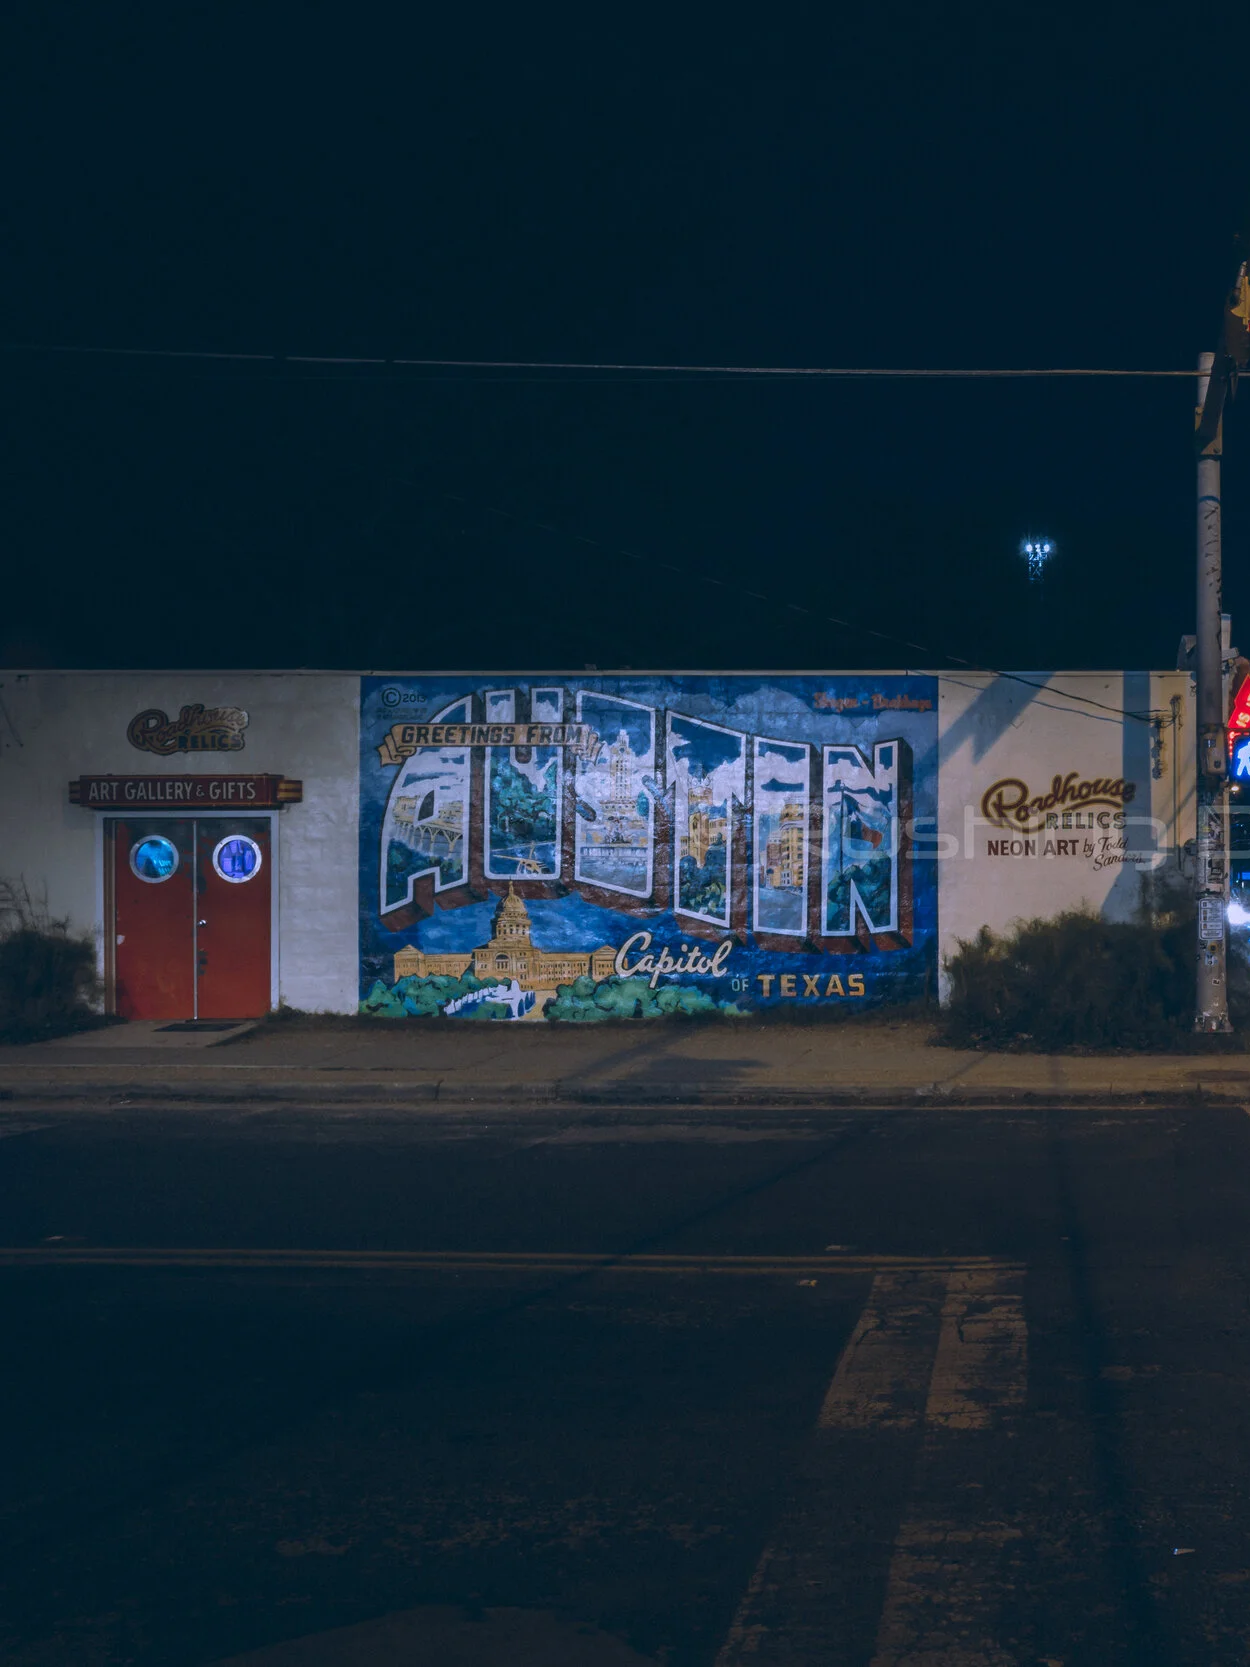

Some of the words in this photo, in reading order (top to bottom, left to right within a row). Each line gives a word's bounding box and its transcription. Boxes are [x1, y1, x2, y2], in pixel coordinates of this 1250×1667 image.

[128, 704, 249, 754] Roadhouse
[1235, 712, 1250, 728] IS
[177, 734, 243, 750] RELICS
[401, 725, 515, 744] GREETINGS
[526, 725, 583, 744] FROM
[88, 781, 118, 800] ART
[124, 781, 193, 800] GALLERY
[195, 784, 205, 798] &
[209, 781, 257, 800] GIFTS
[981, 771, 1136, 834] Roadhouse
[379, 686, 913, 955] AUSTIN
[1045, 811, 1128, 830] RELICS
[987, 839, 1036, 856] NEON
[1043, 839, 1080, 856] ART
[1083, 838, 1096, 858] by
[1097, 836, 1129, 854] Todd
[614, 931, 731, 990] Capitol
[756, 973, 867, 998] TEXAS
